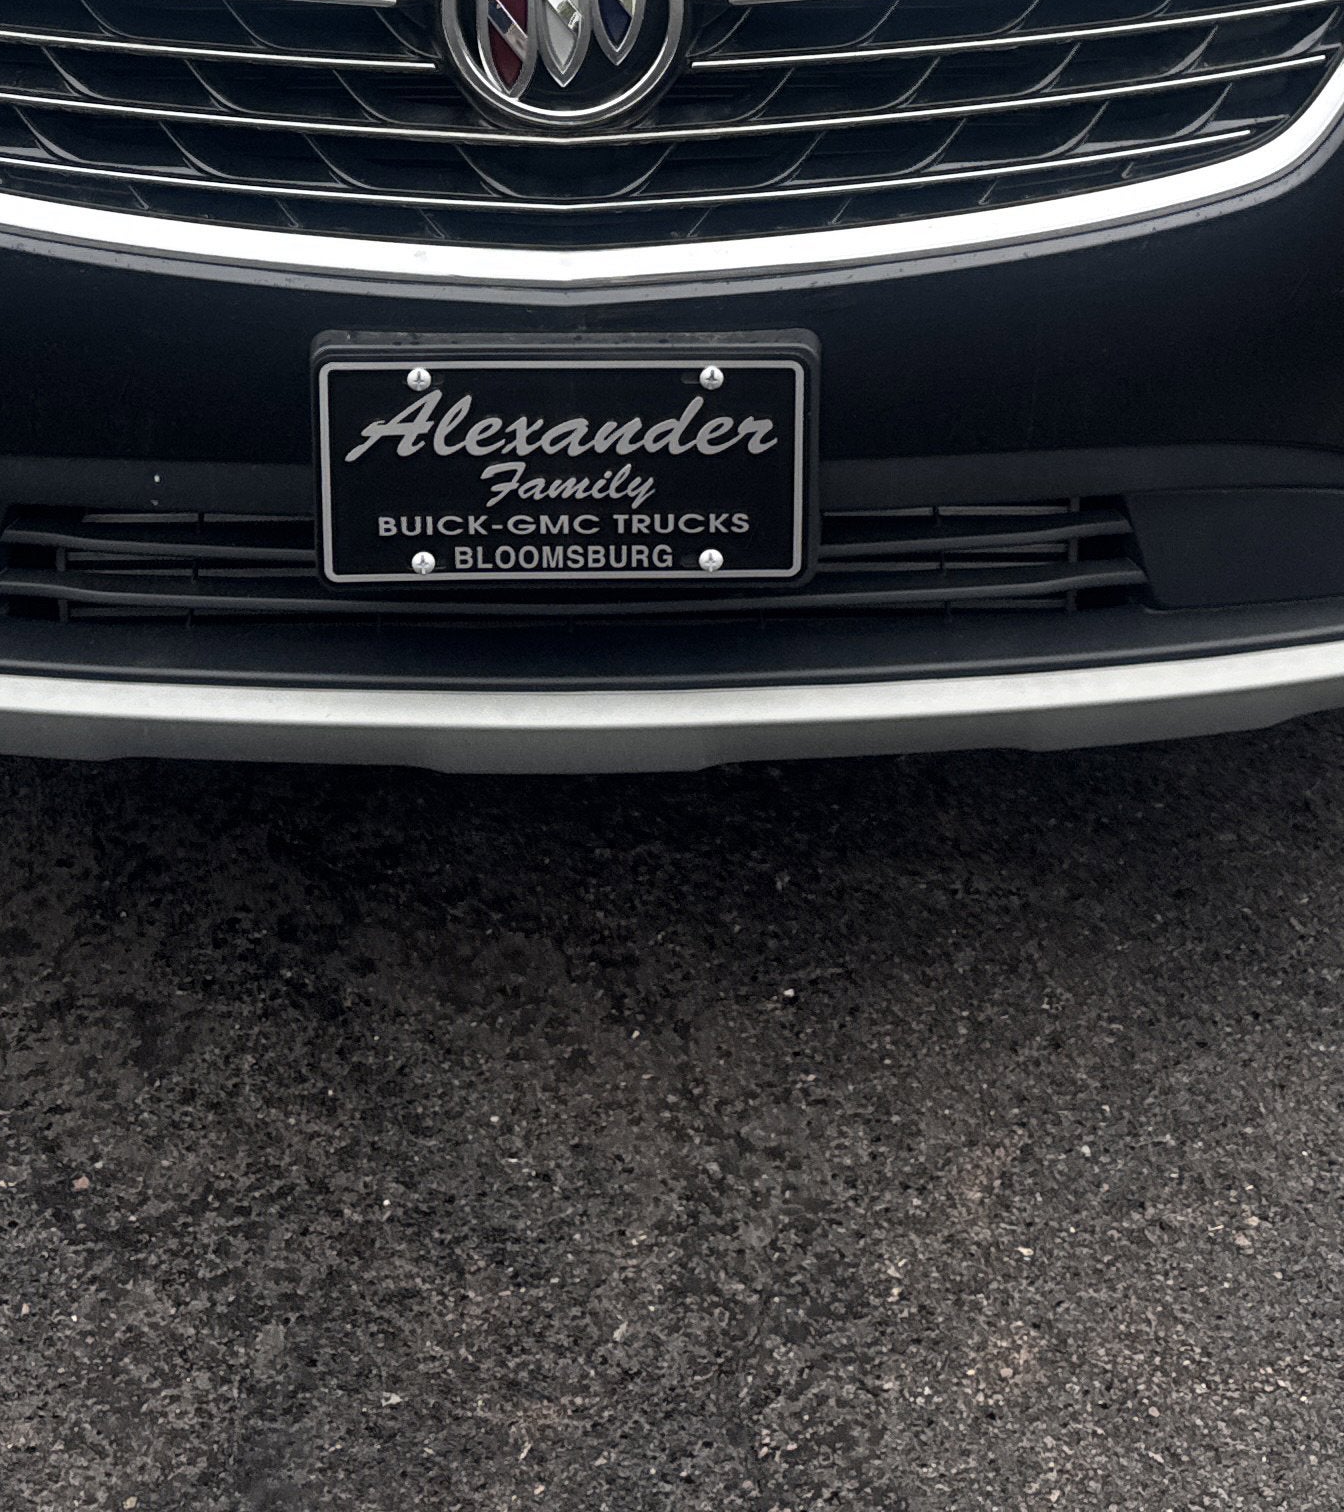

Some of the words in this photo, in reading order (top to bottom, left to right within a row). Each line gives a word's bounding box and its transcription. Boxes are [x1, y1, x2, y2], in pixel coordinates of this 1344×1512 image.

[344, 389, 778, 463] Alexander
[480, 461, 656, 510] Family
[378, 514, 601, 537] BUICK-GMC
[612, 512, 751, 535] TRUCKS
[454, 544, 674, 570] BLOOMSBURG
